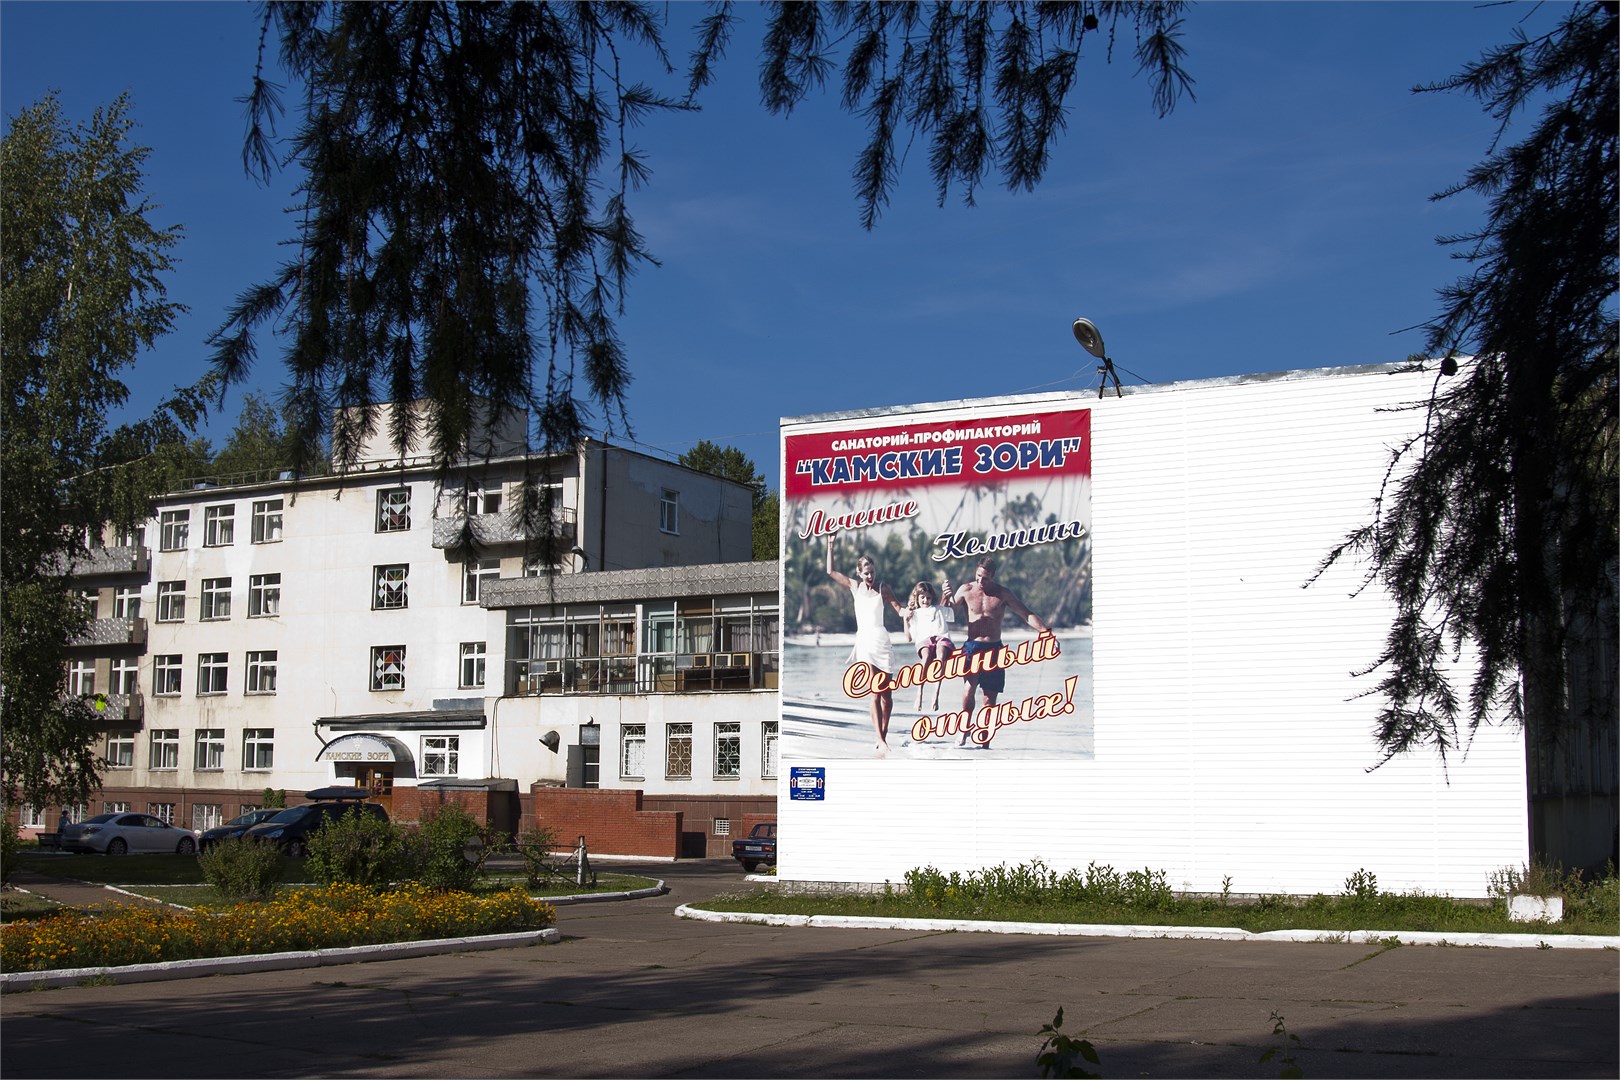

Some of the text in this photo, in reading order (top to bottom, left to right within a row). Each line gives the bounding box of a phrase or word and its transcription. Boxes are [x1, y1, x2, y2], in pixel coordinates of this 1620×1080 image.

[831, 420, 1041, 451] САНАТОРИЙ-ПРОФИЛАКТОРИЙ
[798, 497, 919, 540] Лечение
[931, 519, 1086, 562] Кемпинг
[842, 629, 1061, 699] Семейный
[911, 675, 1079, 745] отдых!
[325, 751, 389, 760] КАМСКИЕ ЗОРИ
